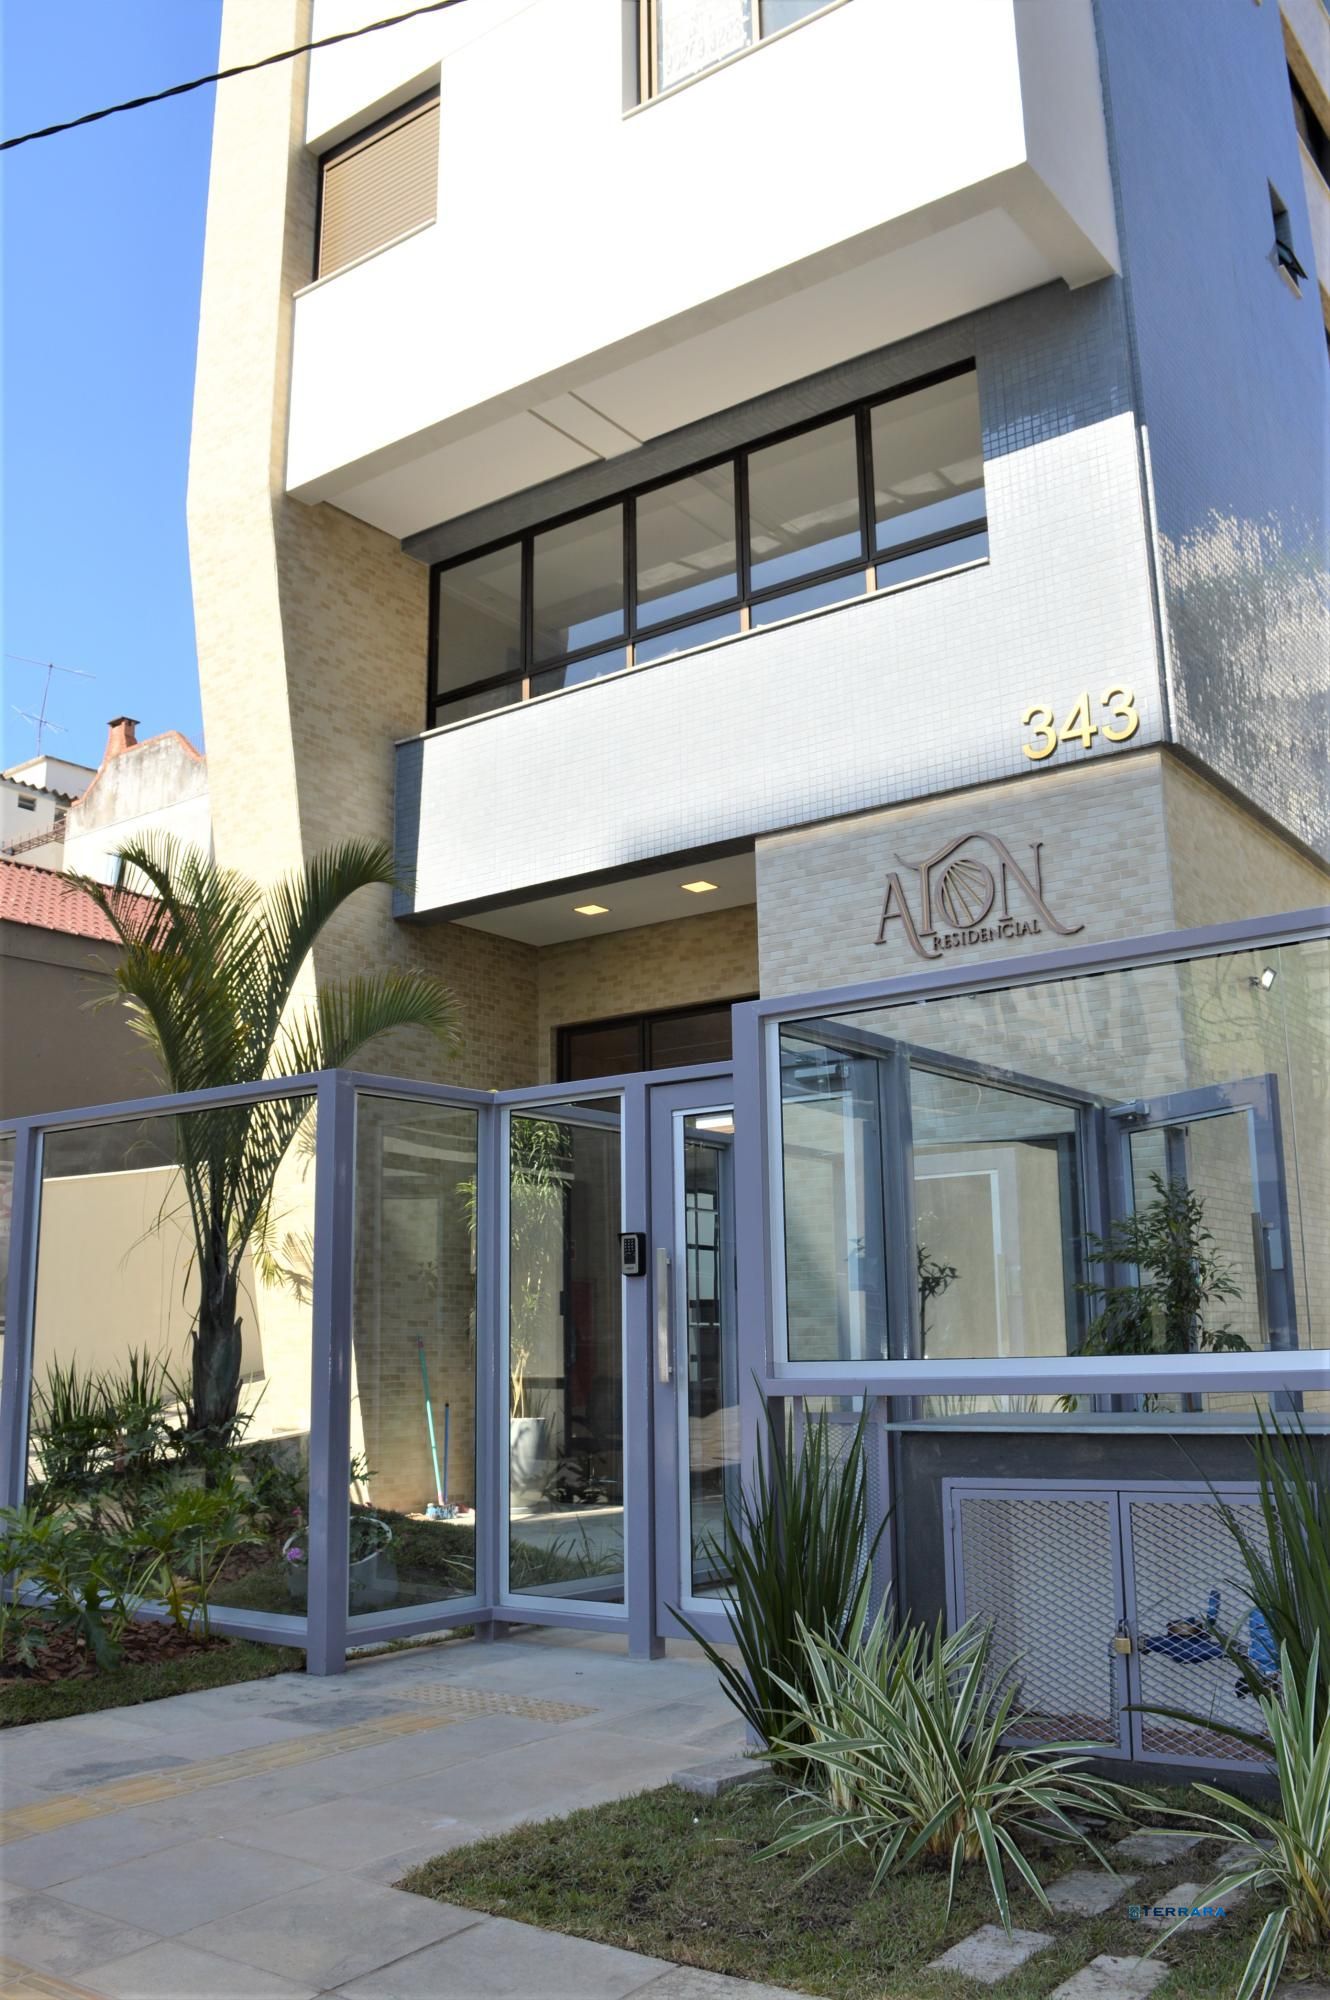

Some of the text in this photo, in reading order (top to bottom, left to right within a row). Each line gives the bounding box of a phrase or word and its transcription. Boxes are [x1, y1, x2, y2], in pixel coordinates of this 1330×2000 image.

[1021, 683, 1140, 761] 343
[873, 831, 1085, 959] ATON
[932, 919, 1042, 951] RESIDENCIAL
